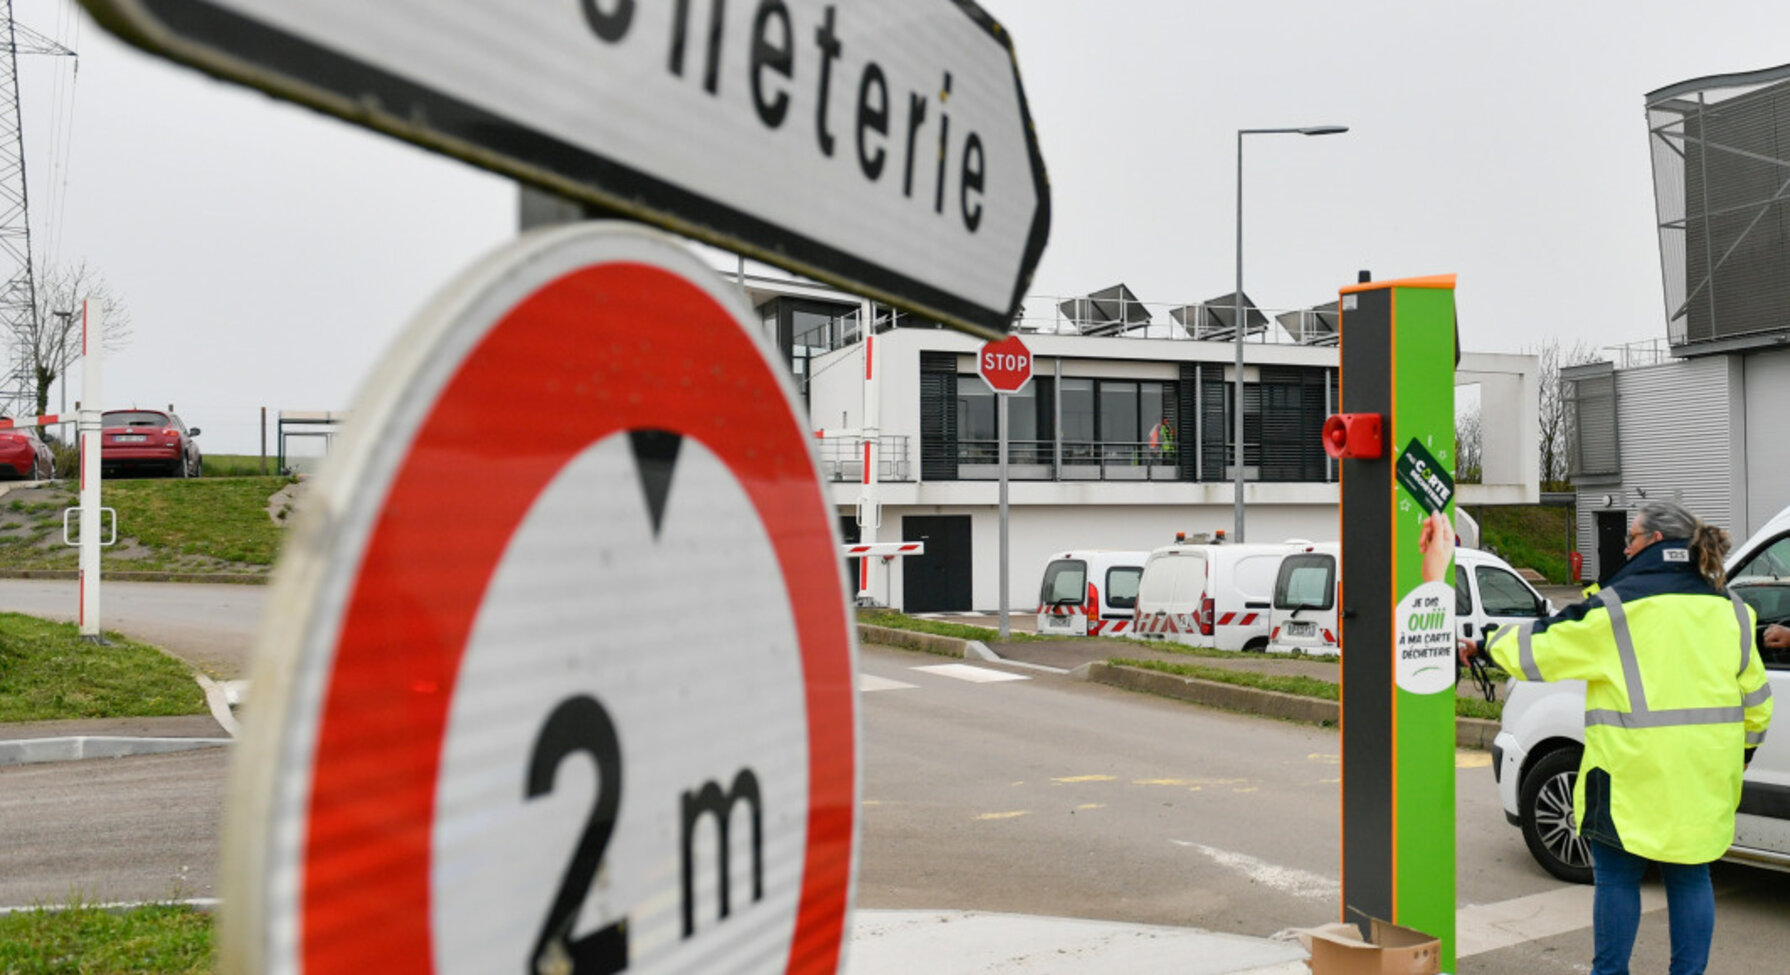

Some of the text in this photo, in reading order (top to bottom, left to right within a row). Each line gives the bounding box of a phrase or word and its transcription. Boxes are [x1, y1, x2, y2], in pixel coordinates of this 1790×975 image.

[984, 353, 1027, 372] STOP
[1412, 596, 1439, 608] JE DIS
[1408, 634, 1422, 644] MA
[1424, 632, 1452, 644] CARTE
[523, 693, 763, 975] 2 m
